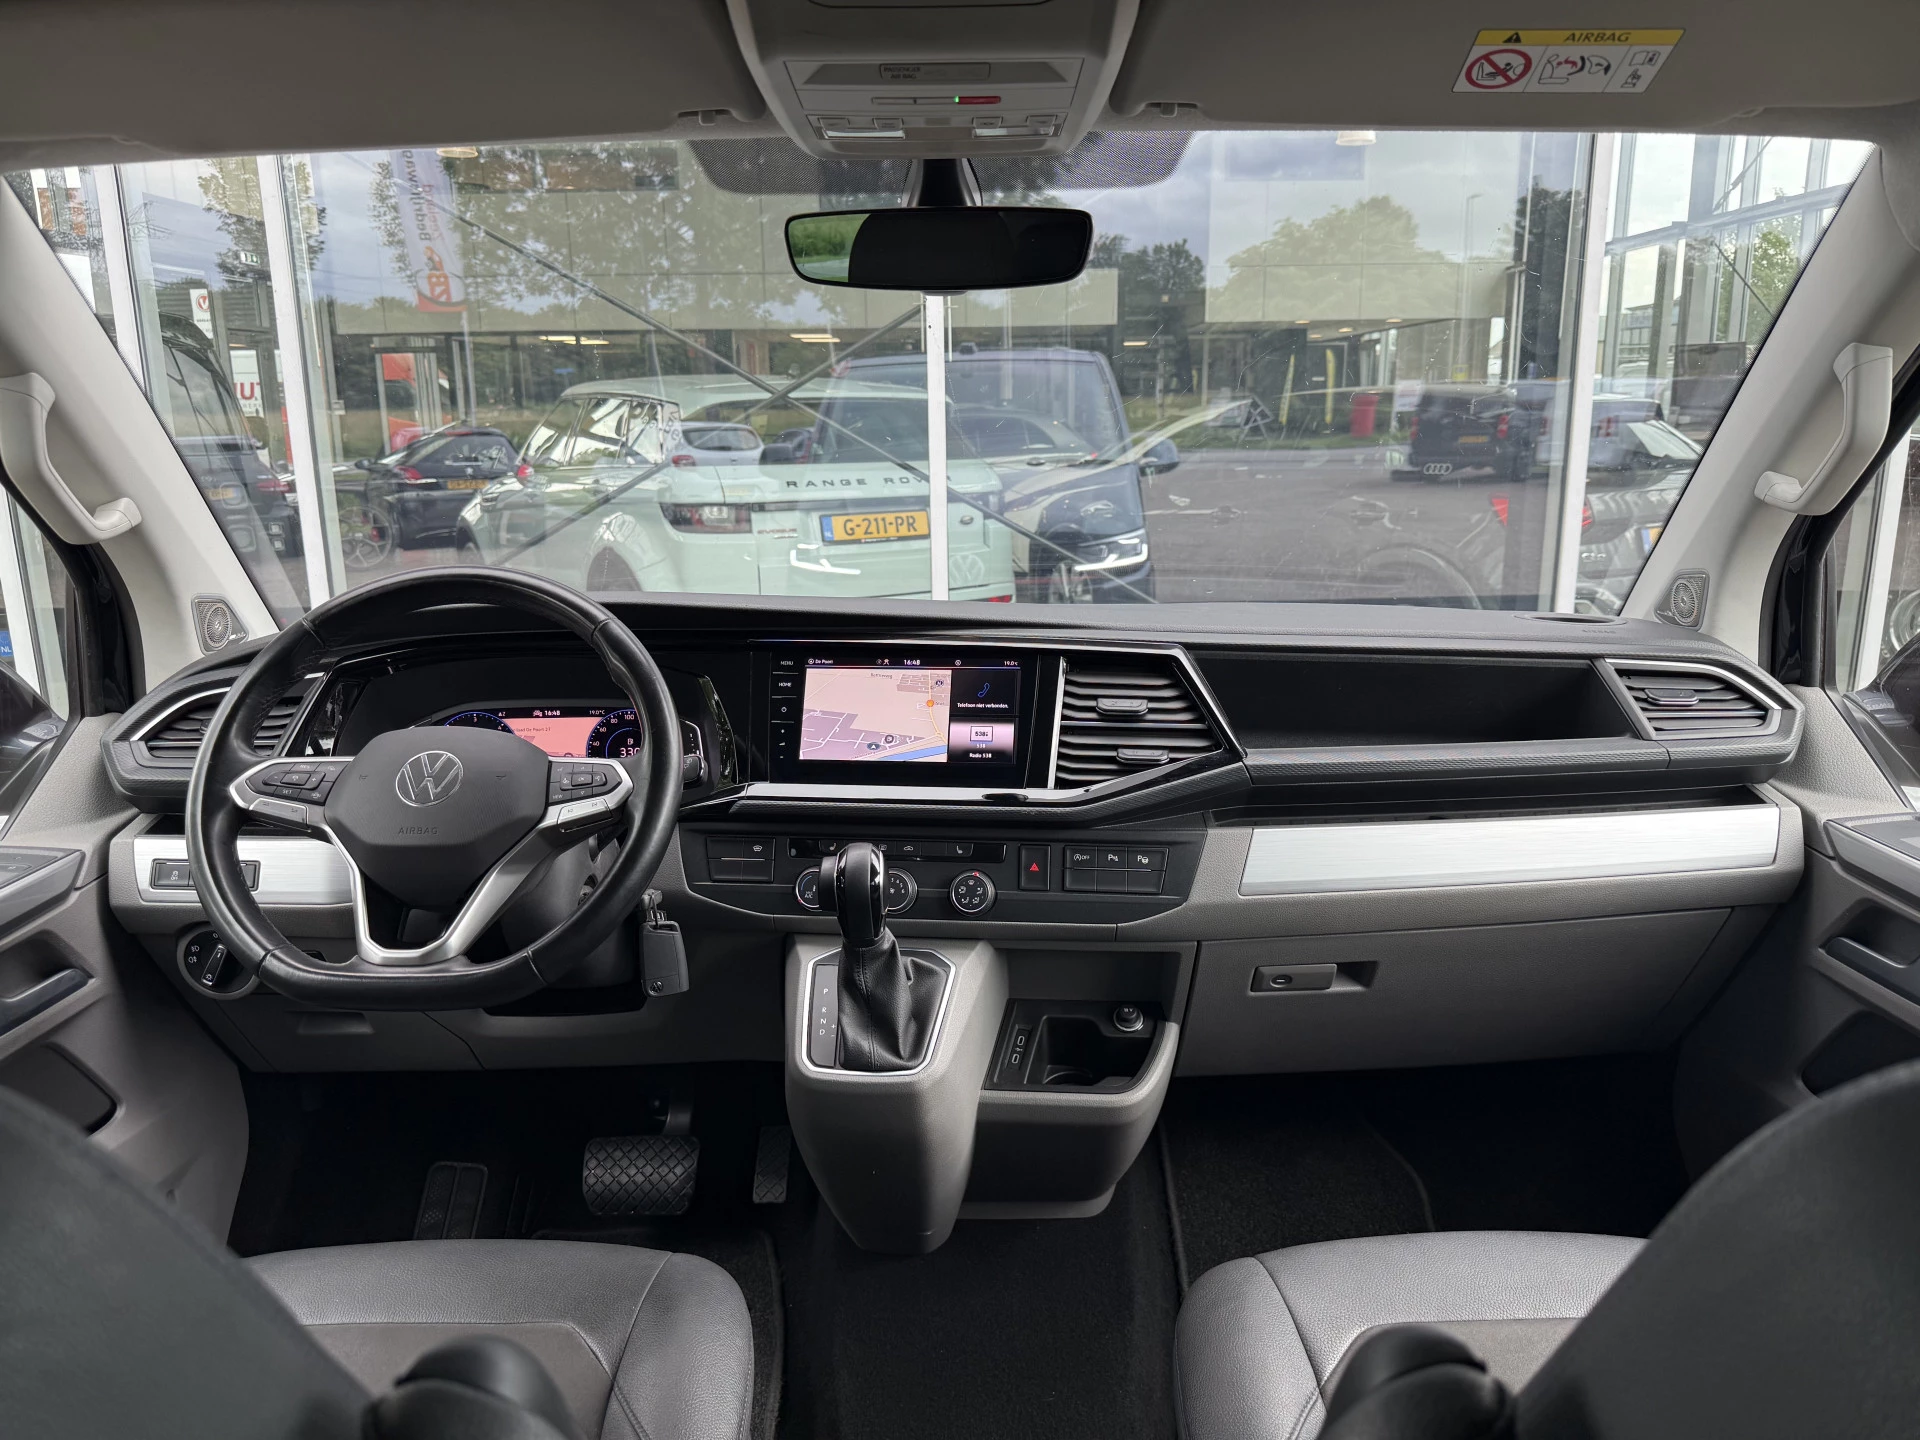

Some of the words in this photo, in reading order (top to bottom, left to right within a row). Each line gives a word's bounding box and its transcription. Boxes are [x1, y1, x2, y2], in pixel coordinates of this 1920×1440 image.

[1563, 32, 1631, 43] AIRBAG
[786, 478, 867, 488] RANGE
[843, 515, 918, 536] G-211-PR
[398, 827, 438, 835] AIRBAG
